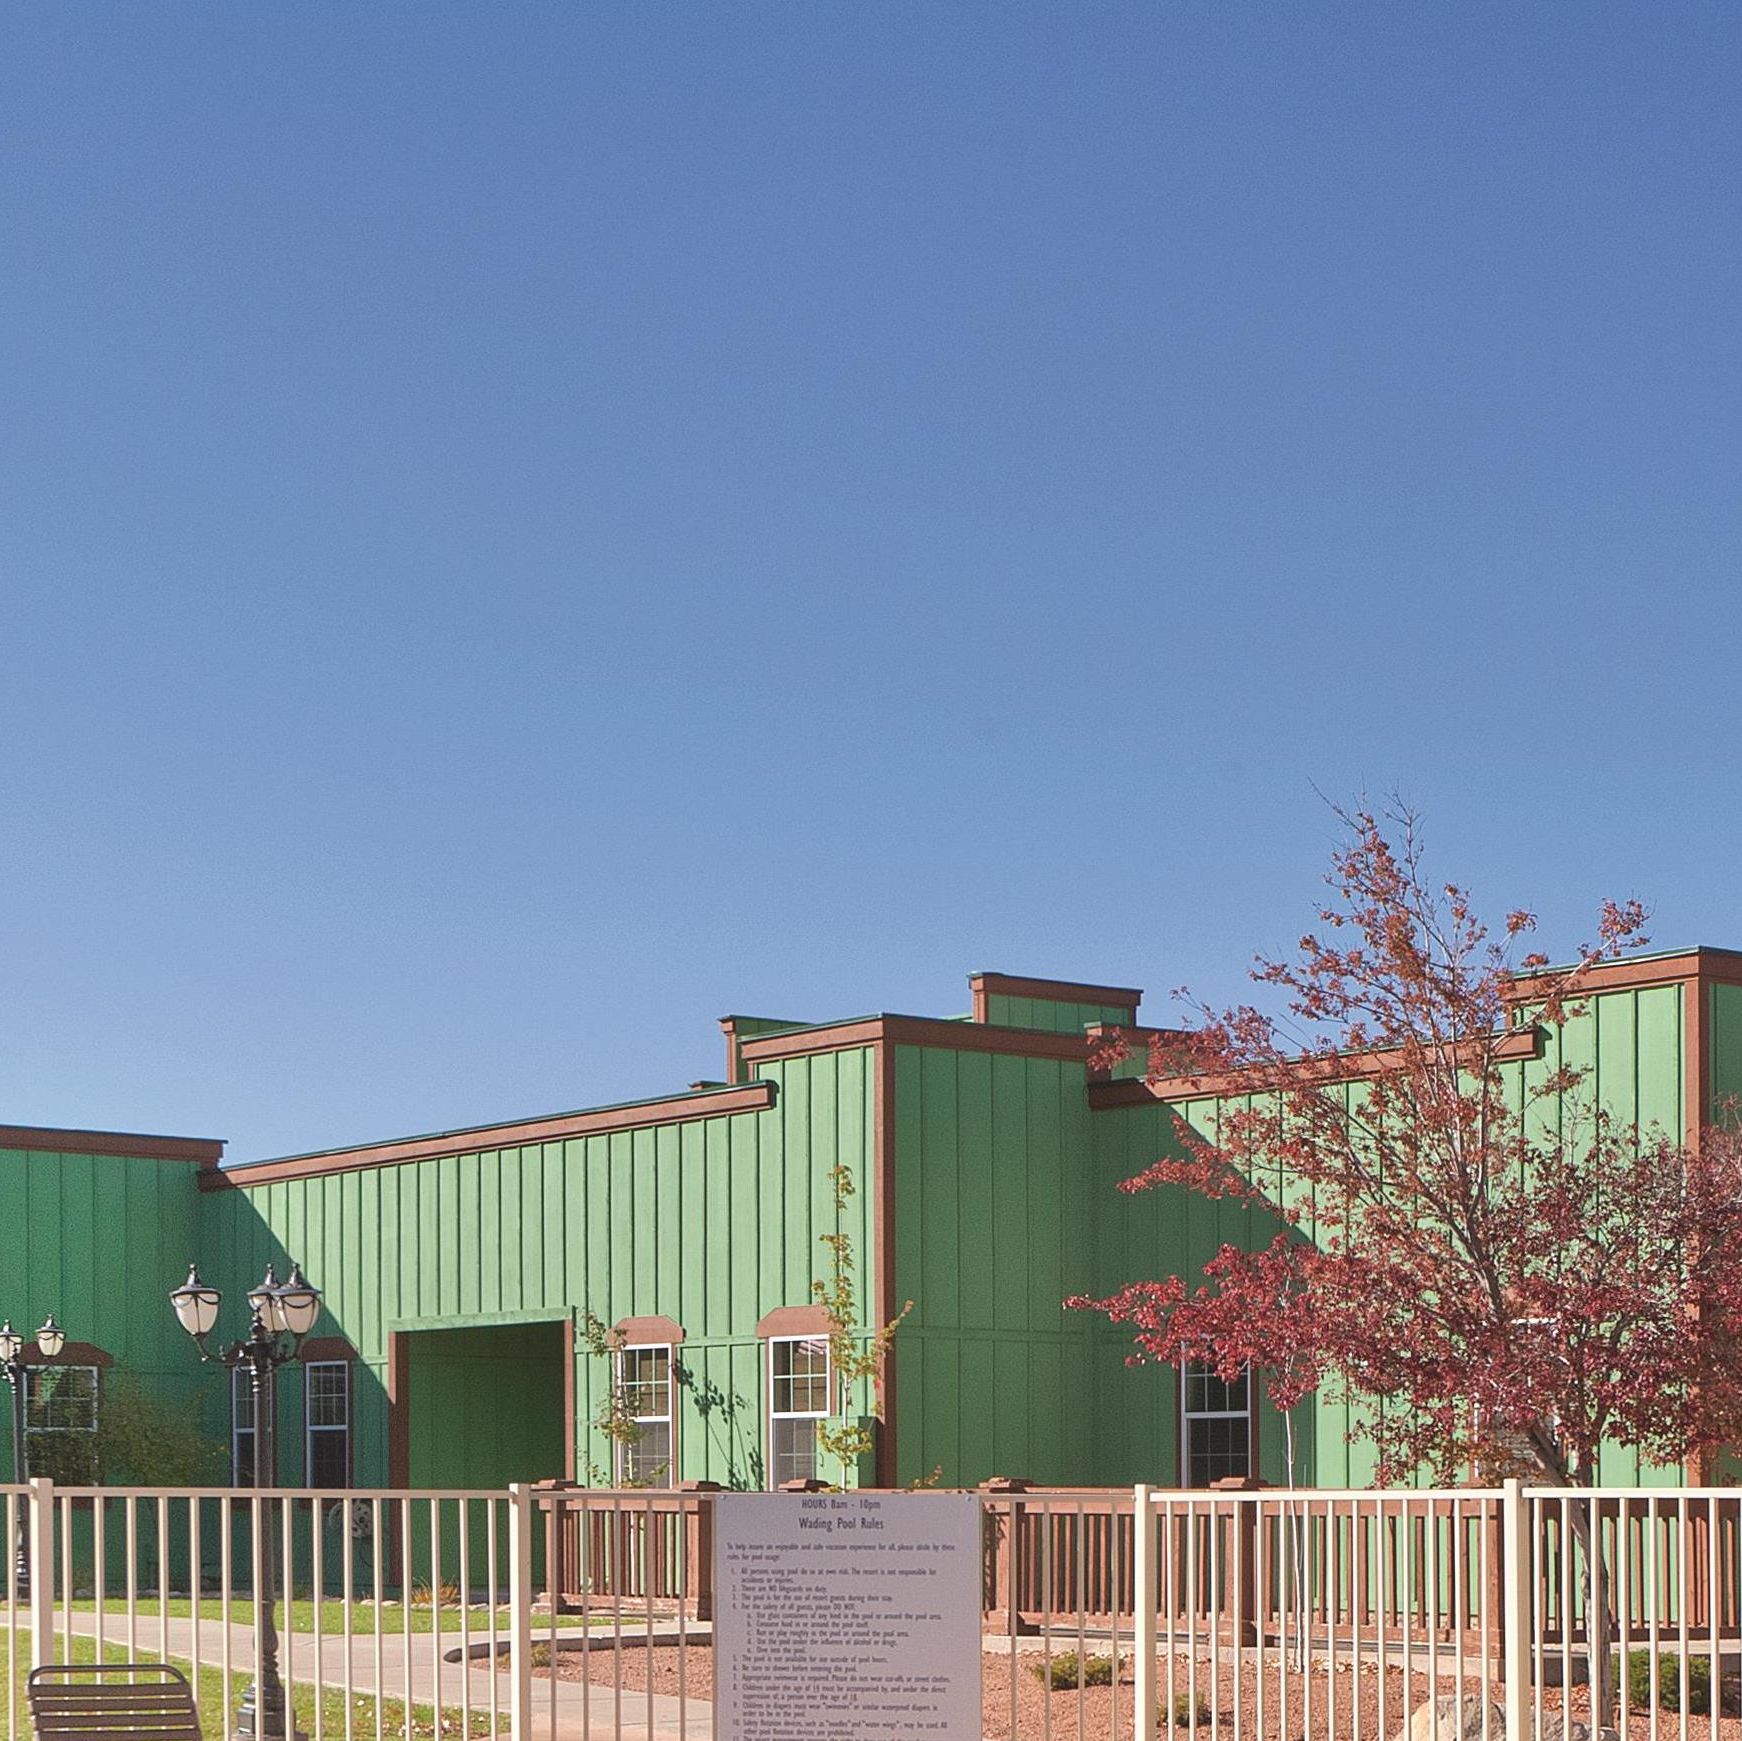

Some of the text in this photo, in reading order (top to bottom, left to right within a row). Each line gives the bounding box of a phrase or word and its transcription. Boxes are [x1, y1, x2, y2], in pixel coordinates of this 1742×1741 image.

[802, 1499, 827, 1508] HOURS
[831, 1500, 847, 1508] 8am
[860, 1500, 880, 1511] 10pm
[799, 1517, 883, 1532] Wading Pool Rules
